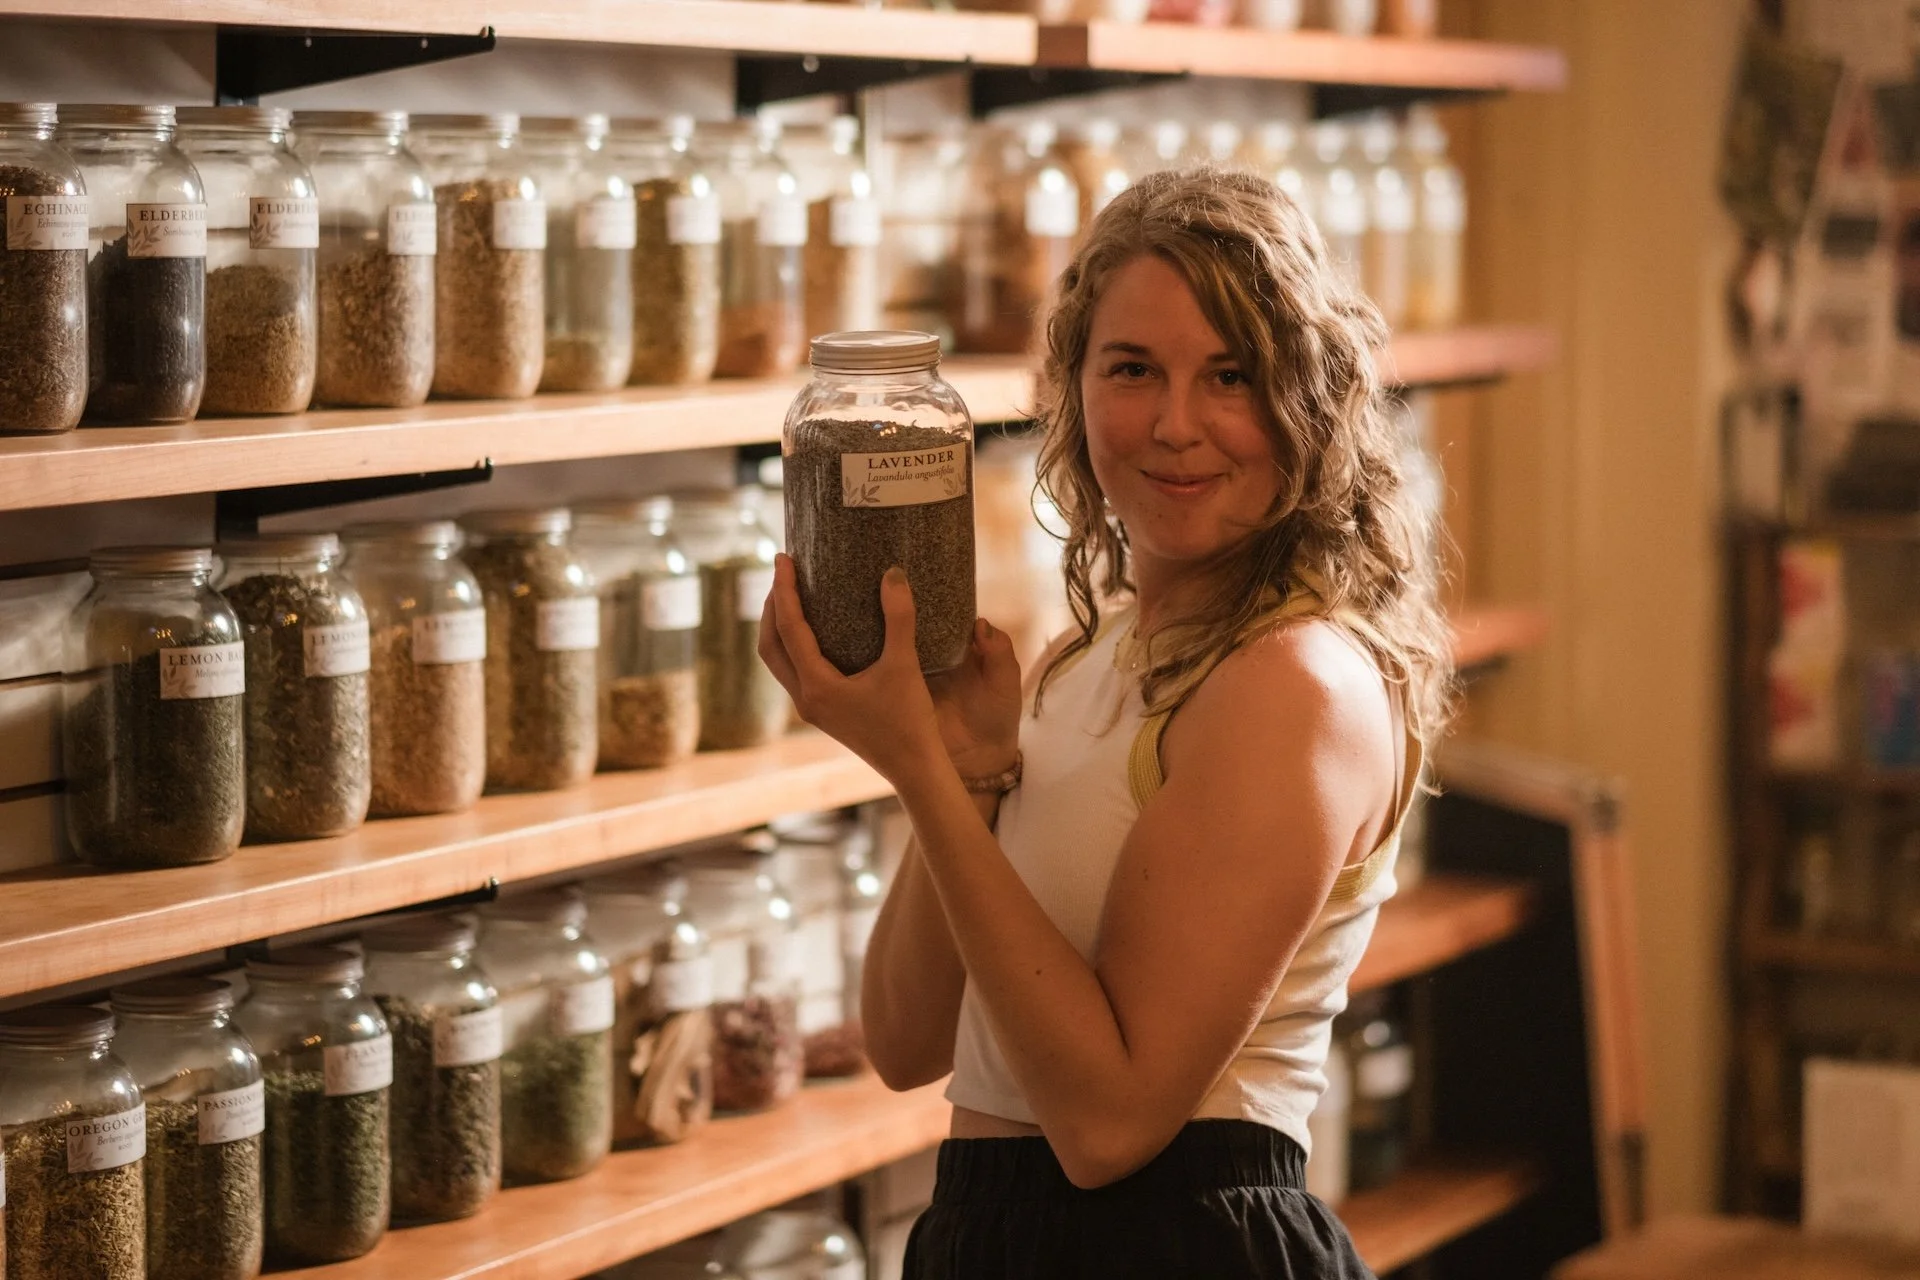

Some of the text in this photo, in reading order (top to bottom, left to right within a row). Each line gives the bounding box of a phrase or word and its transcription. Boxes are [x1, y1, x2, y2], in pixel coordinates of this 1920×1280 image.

[868, 450, 955, 470] LAVENDER
[168, 651, 223, 666] LEMON
[69, 1117, 129, 1137] OREGON
